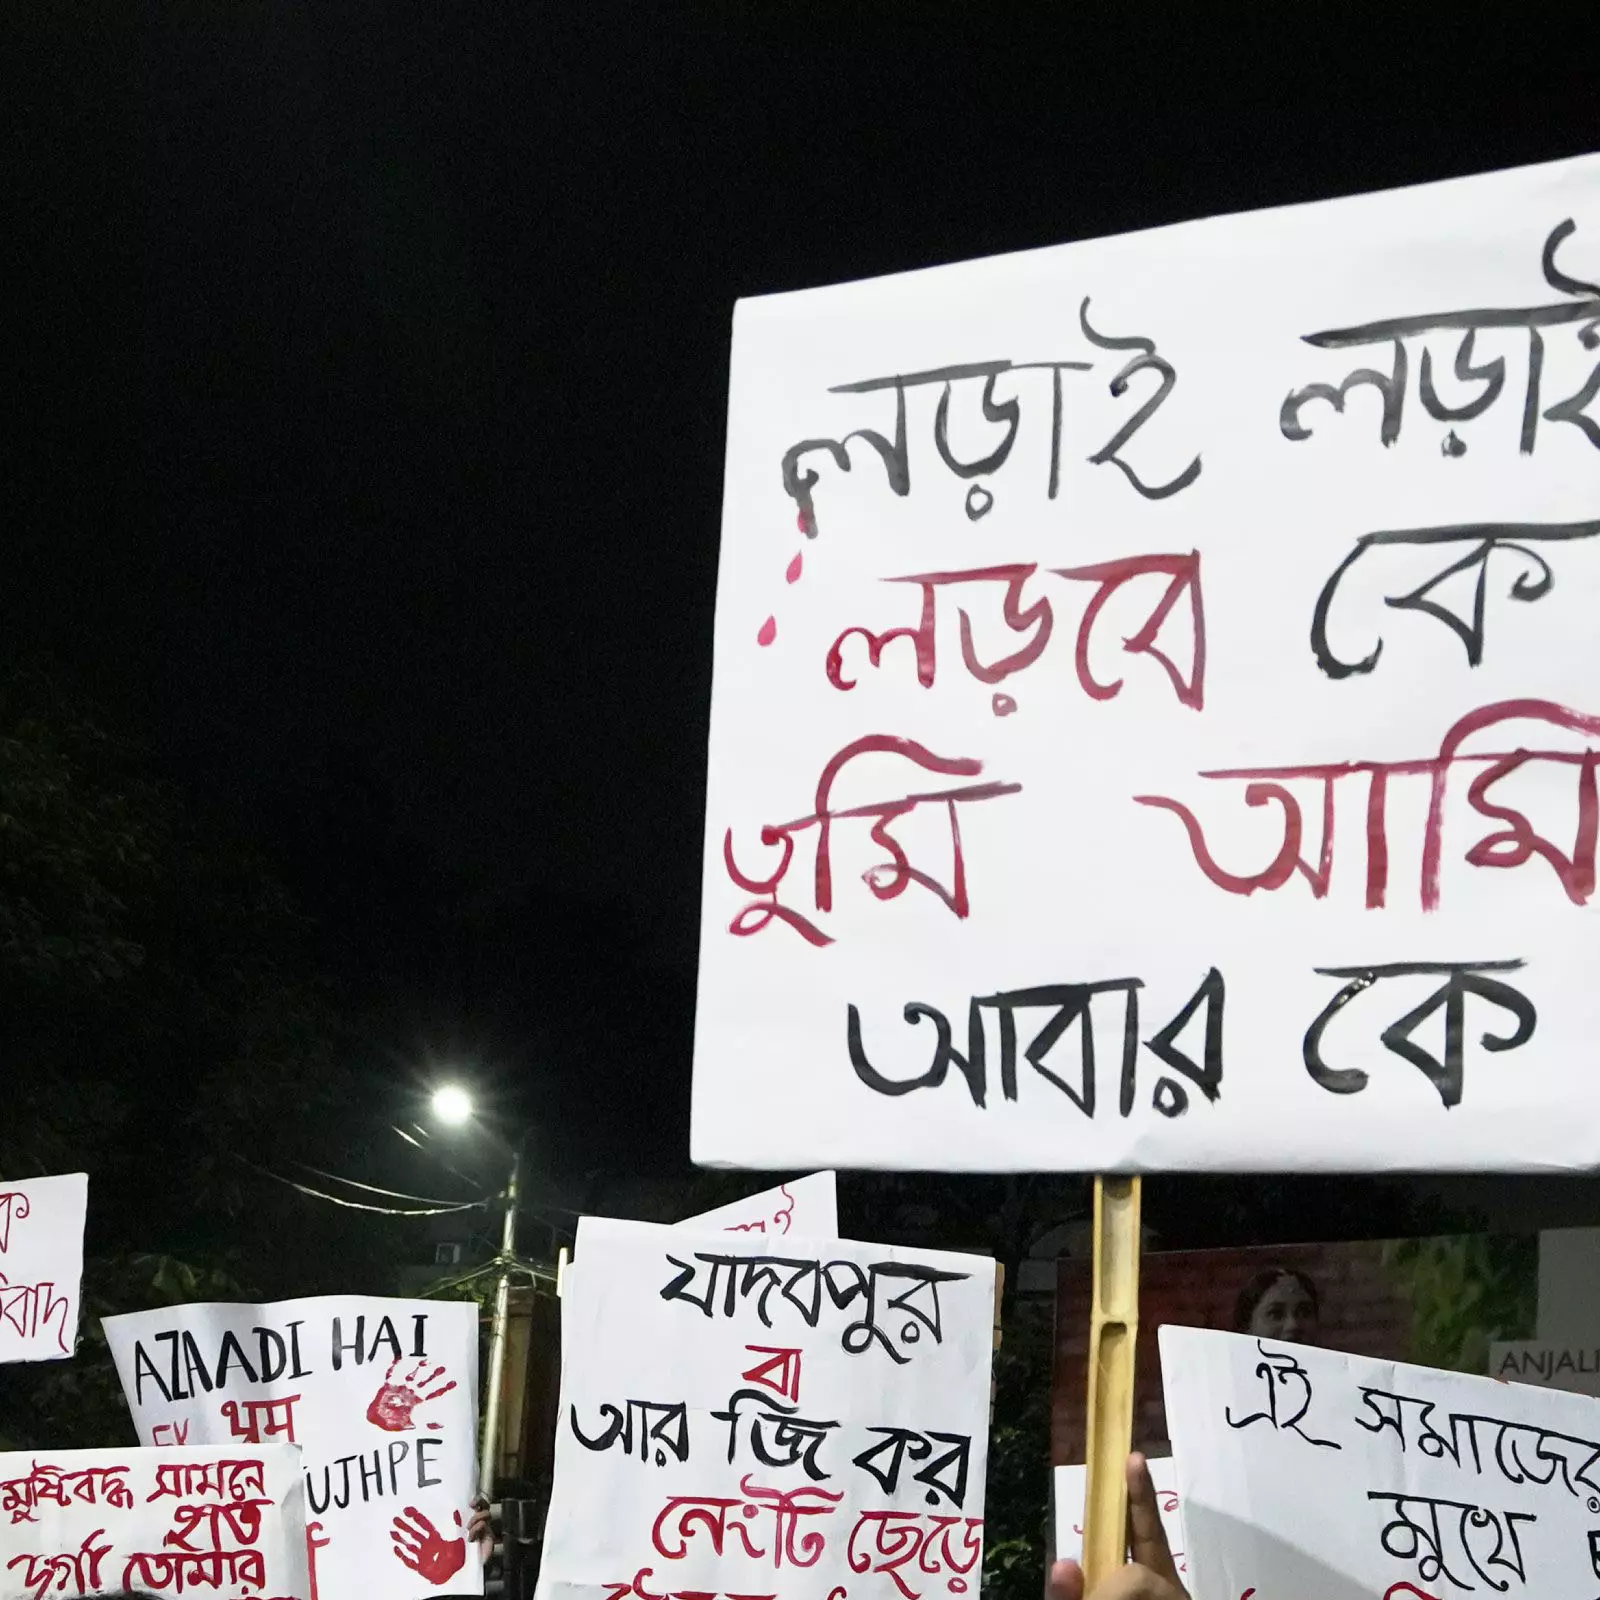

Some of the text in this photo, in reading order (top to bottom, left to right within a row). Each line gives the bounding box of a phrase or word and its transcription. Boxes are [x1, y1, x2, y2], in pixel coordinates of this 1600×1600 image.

[782, 295, 1203, 538] লড়াই
[825, 549, 1205, 717] লড়বে
[723, 734, 1021, 947] তুমি
[846, 958, 1538, 1120] আবার কে
[135, 1314, 429, 1406] AZAADI HAI
[659, 1252, 973, 1364] যাদবপুর
[741, 1344, 803, 1402] বা
[1226, 1338, 1341, 1449] এই
[1500, 1348, 1600, 1380] ANJALI
[303, 1438, 444, 1515] UJHPE
[570, 1389, 972, 1510] আর জি কর
[1367, 1490, 1537, 1592] মুখে
